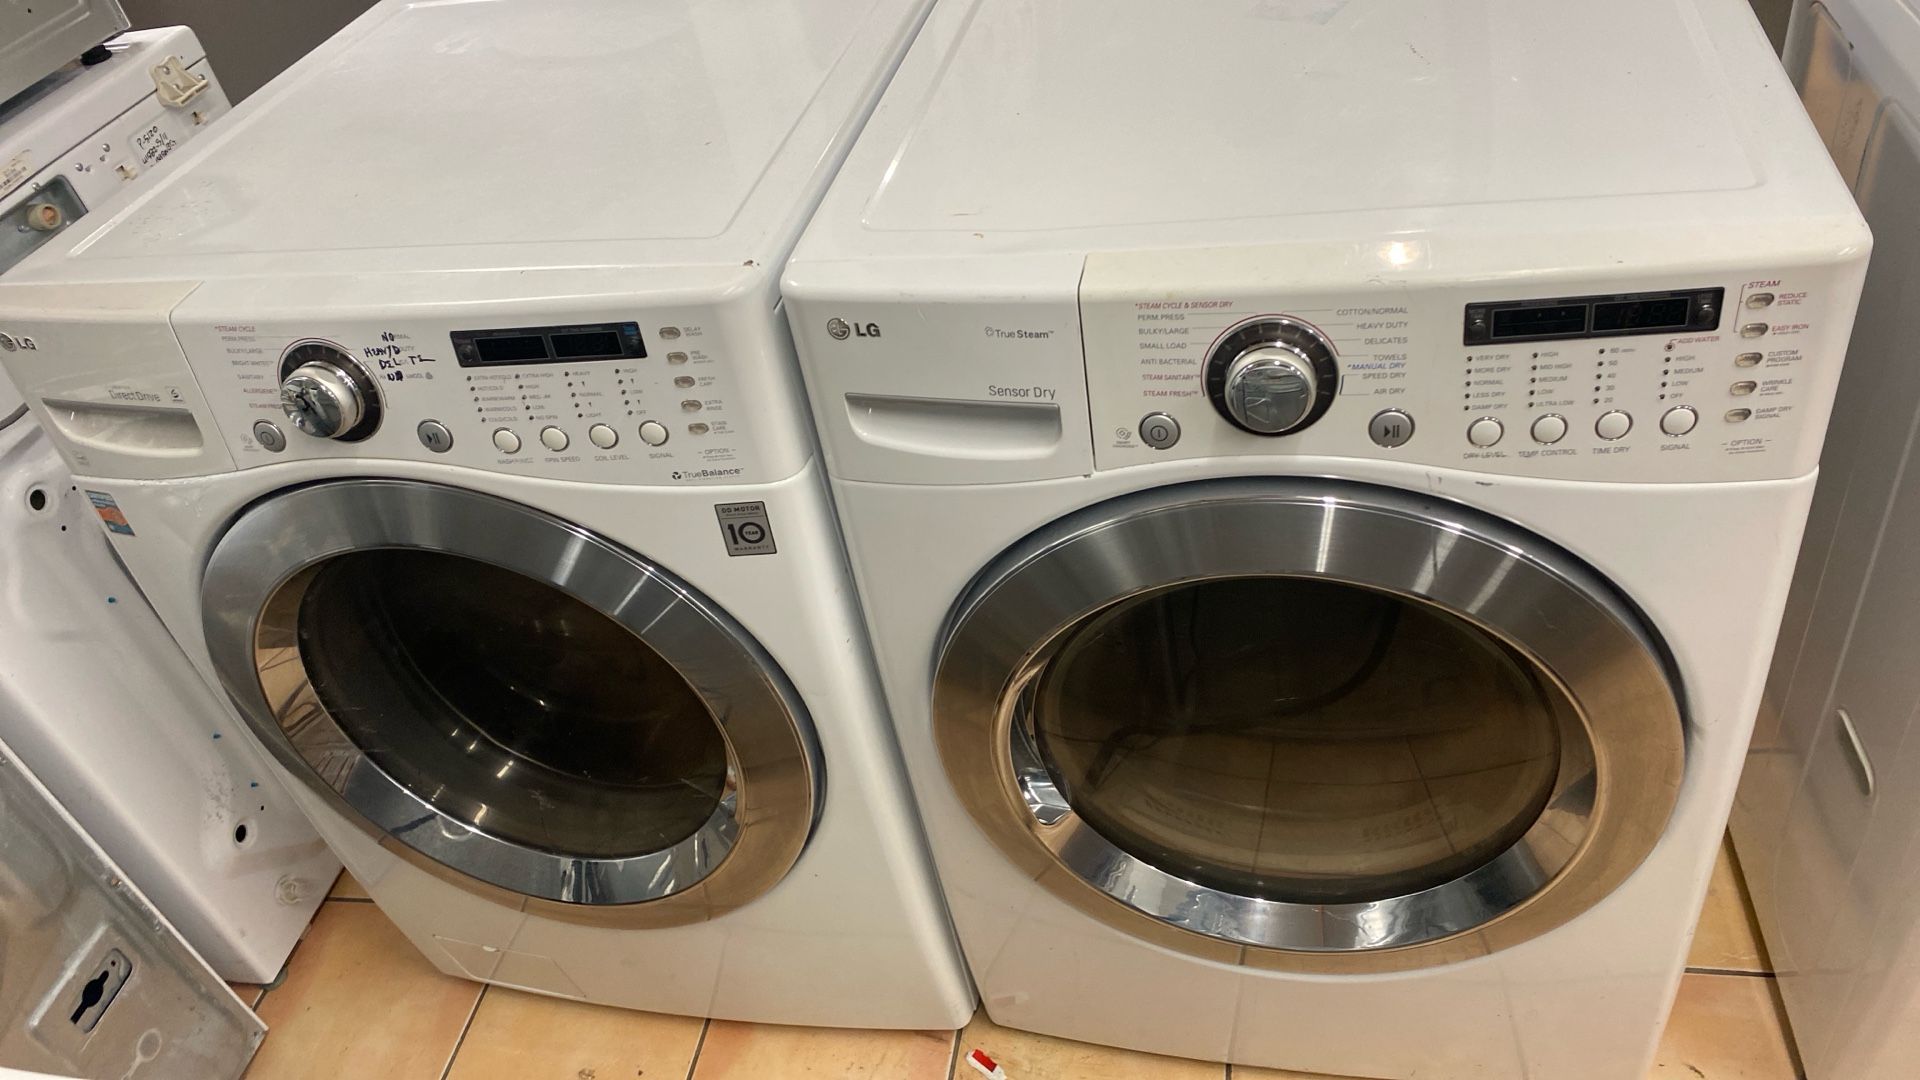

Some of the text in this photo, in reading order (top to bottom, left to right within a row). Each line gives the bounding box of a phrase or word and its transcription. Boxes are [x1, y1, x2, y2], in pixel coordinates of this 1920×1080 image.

[1747, 280, 1781, 289] STEAM
[1190, 301, 1219, 309] SENSOR
[855, 322, 881, 338] LG
[1356, 321, 1408, 330] HEAVY DUTY
[16, 336, 37, 350] LG
[1364, 336, 1408, 345] DELICATES
[1695, 335, 1720, 343] WATER
[1373, 353, 1407, 361] TOWELS
[1766, 355, 1803, 363] PROGRAM
[1673, 367, 1704, 375] MEDIUM
[988, 385, 1056, 400] Sensor Dry
[1389, 387, 1406, 395] DRY
[1730, 438, 1762, 447] OPTION
[1592, 446, 1631, 455] TIME DRY
[1660, 443, 1691, 452] SIGNAL
[1540, 448, 1577, 457] CONTROL
[728, 522, 765, 545] 10
